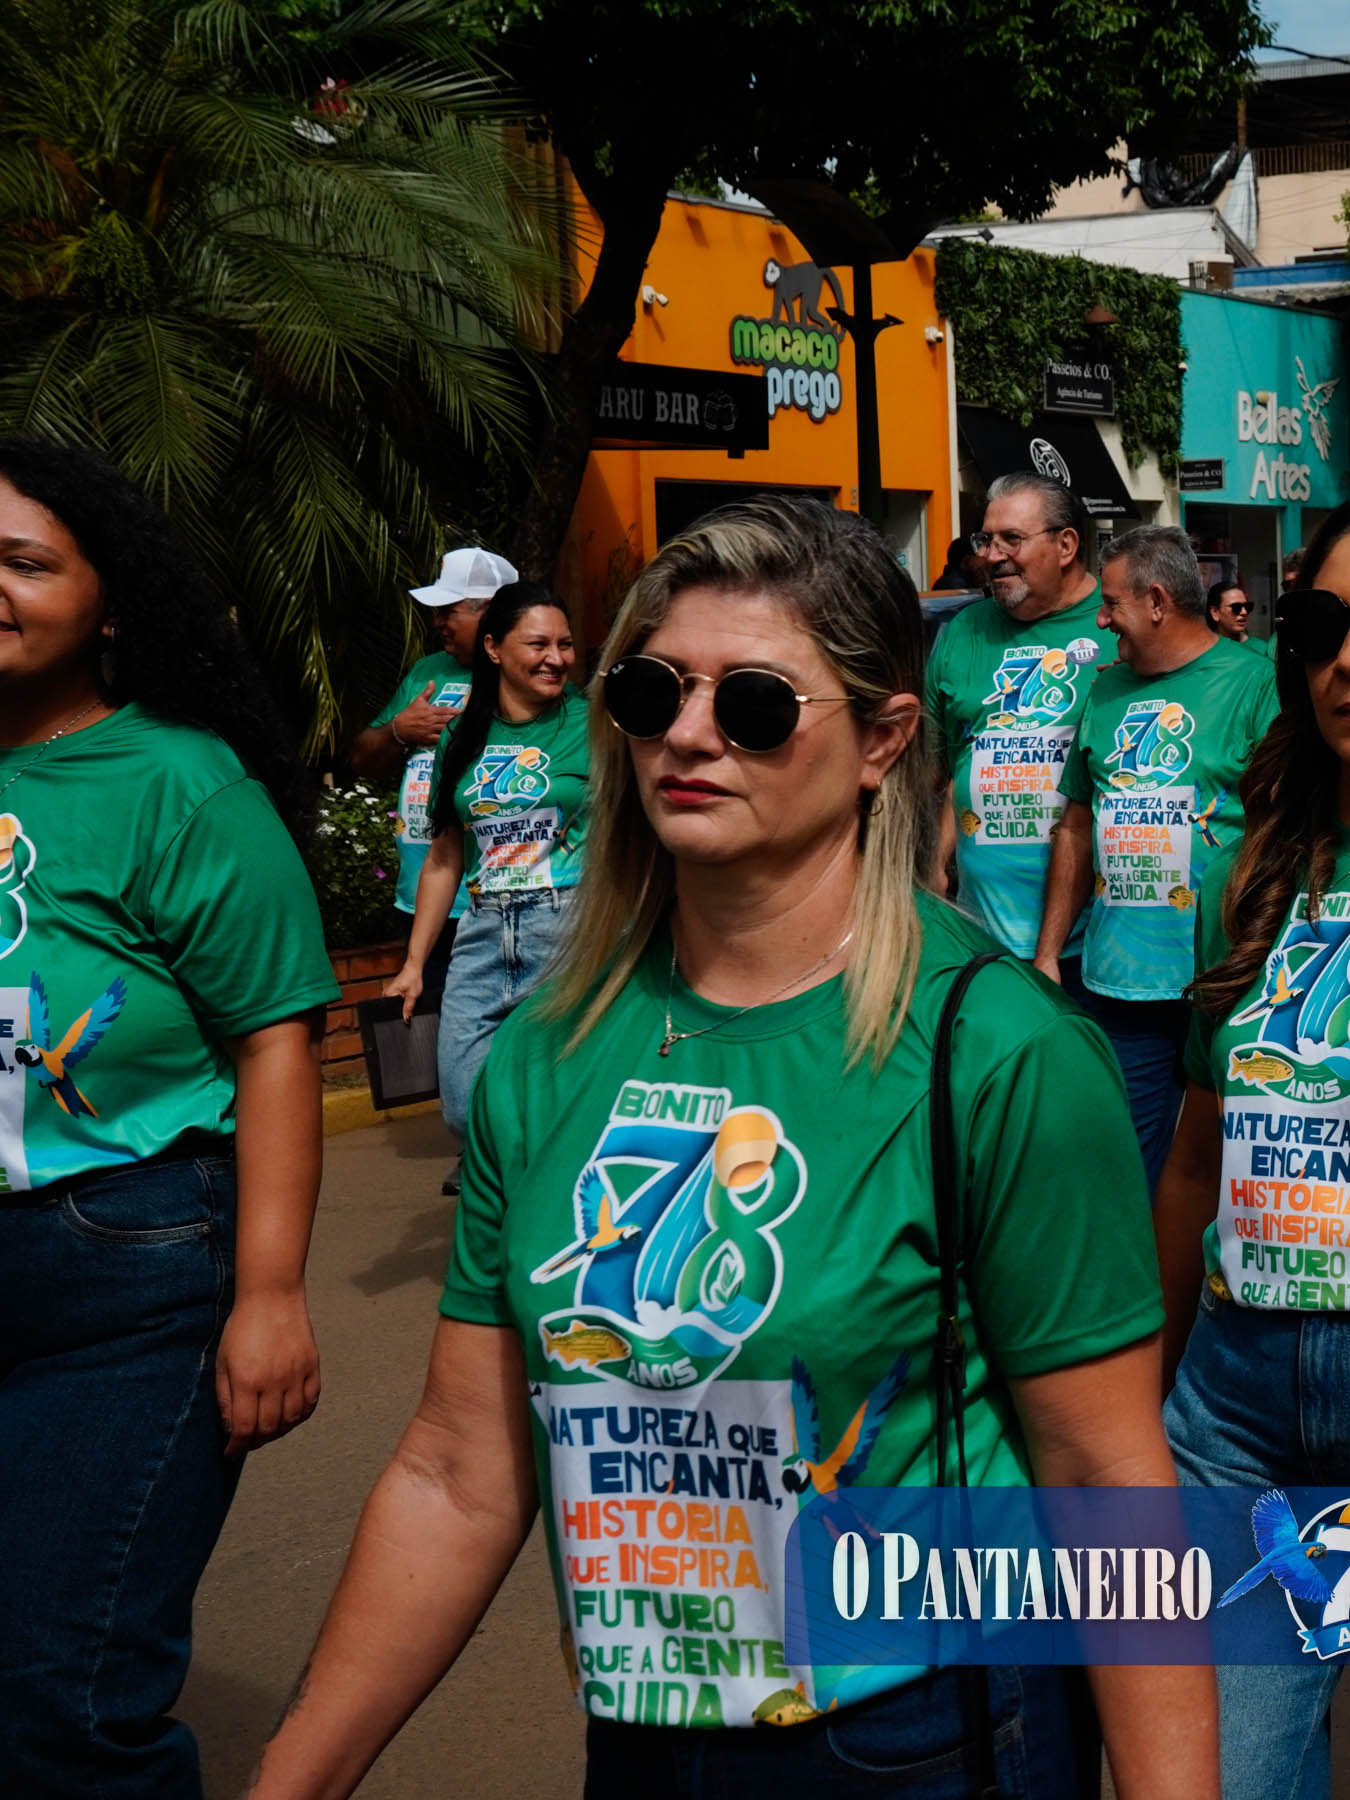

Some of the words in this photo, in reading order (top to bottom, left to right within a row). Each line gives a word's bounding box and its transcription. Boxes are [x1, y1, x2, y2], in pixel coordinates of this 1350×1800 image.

[733, 318, 838, 370] macaco
[1046, 357, 1082, 378] Passeios
[1083, 366, 1093, 379] &
[598, 384, 645, 421] ARU
[654, 390, 700, 426] BAR
[767, 366, 841, 419] prego
[1238, 391, 1302, 446] Bellas
[1249, 449, 1311, 501] Artes
[1006, 647, 1045, 658] BONITO
[995, 648, 1078, 714] 78
[1128, 700, 1165, 713] BONITO
[975, 736, 1043, 750] NATUREZA
[1116, 702, 1195, 772] 78
[474, 747, 551, 800] 78
[983, 793, 1043, 806] FUTURO
[985, 810, 1003, 821] QUE
[1013, 807, 1062, 820] GENTE
[1167, 800, 1189, 810] QUE
[534, 819, 553, 829] QUE
[985, 822, 1043, 838] CUIDA.
[1114, 811, 1188, 826] ENCANTA,
[1107, 855, 1162, 868] FUTURO
[1108, 872, 1124, 883] QUE
[1132, 870, 1181, 883] GENTE
[616, 1086, 724, 1125] BONITO
[1284, 1079, 1341, 1101] ANOS
[574, 1104, 808, 1332] 78
[1234, 1218, 1259, 1239] QUE
[1242, 1242, 1345, 1279] FUTURO
[1241, 1282, 1270, 1305] QUE
[1272, 1286, 1280, 1304] A
[627, 1357, 698, 1389] ANOS
[728, 1424, 778, 1456] QUE
[590, 1450, 783, 1510] ENCANTA,
[619, 1544, 768, 1595] INSPIRA,
[573, 1589, 735, 1634] FUTURO
[579, 1645, 632, 1678] QUE
[641, 1646, 653, 1674] A
[663, 1636, 790, 1679] GENTE
[584, 1680, 727, 1729] CUIDA
